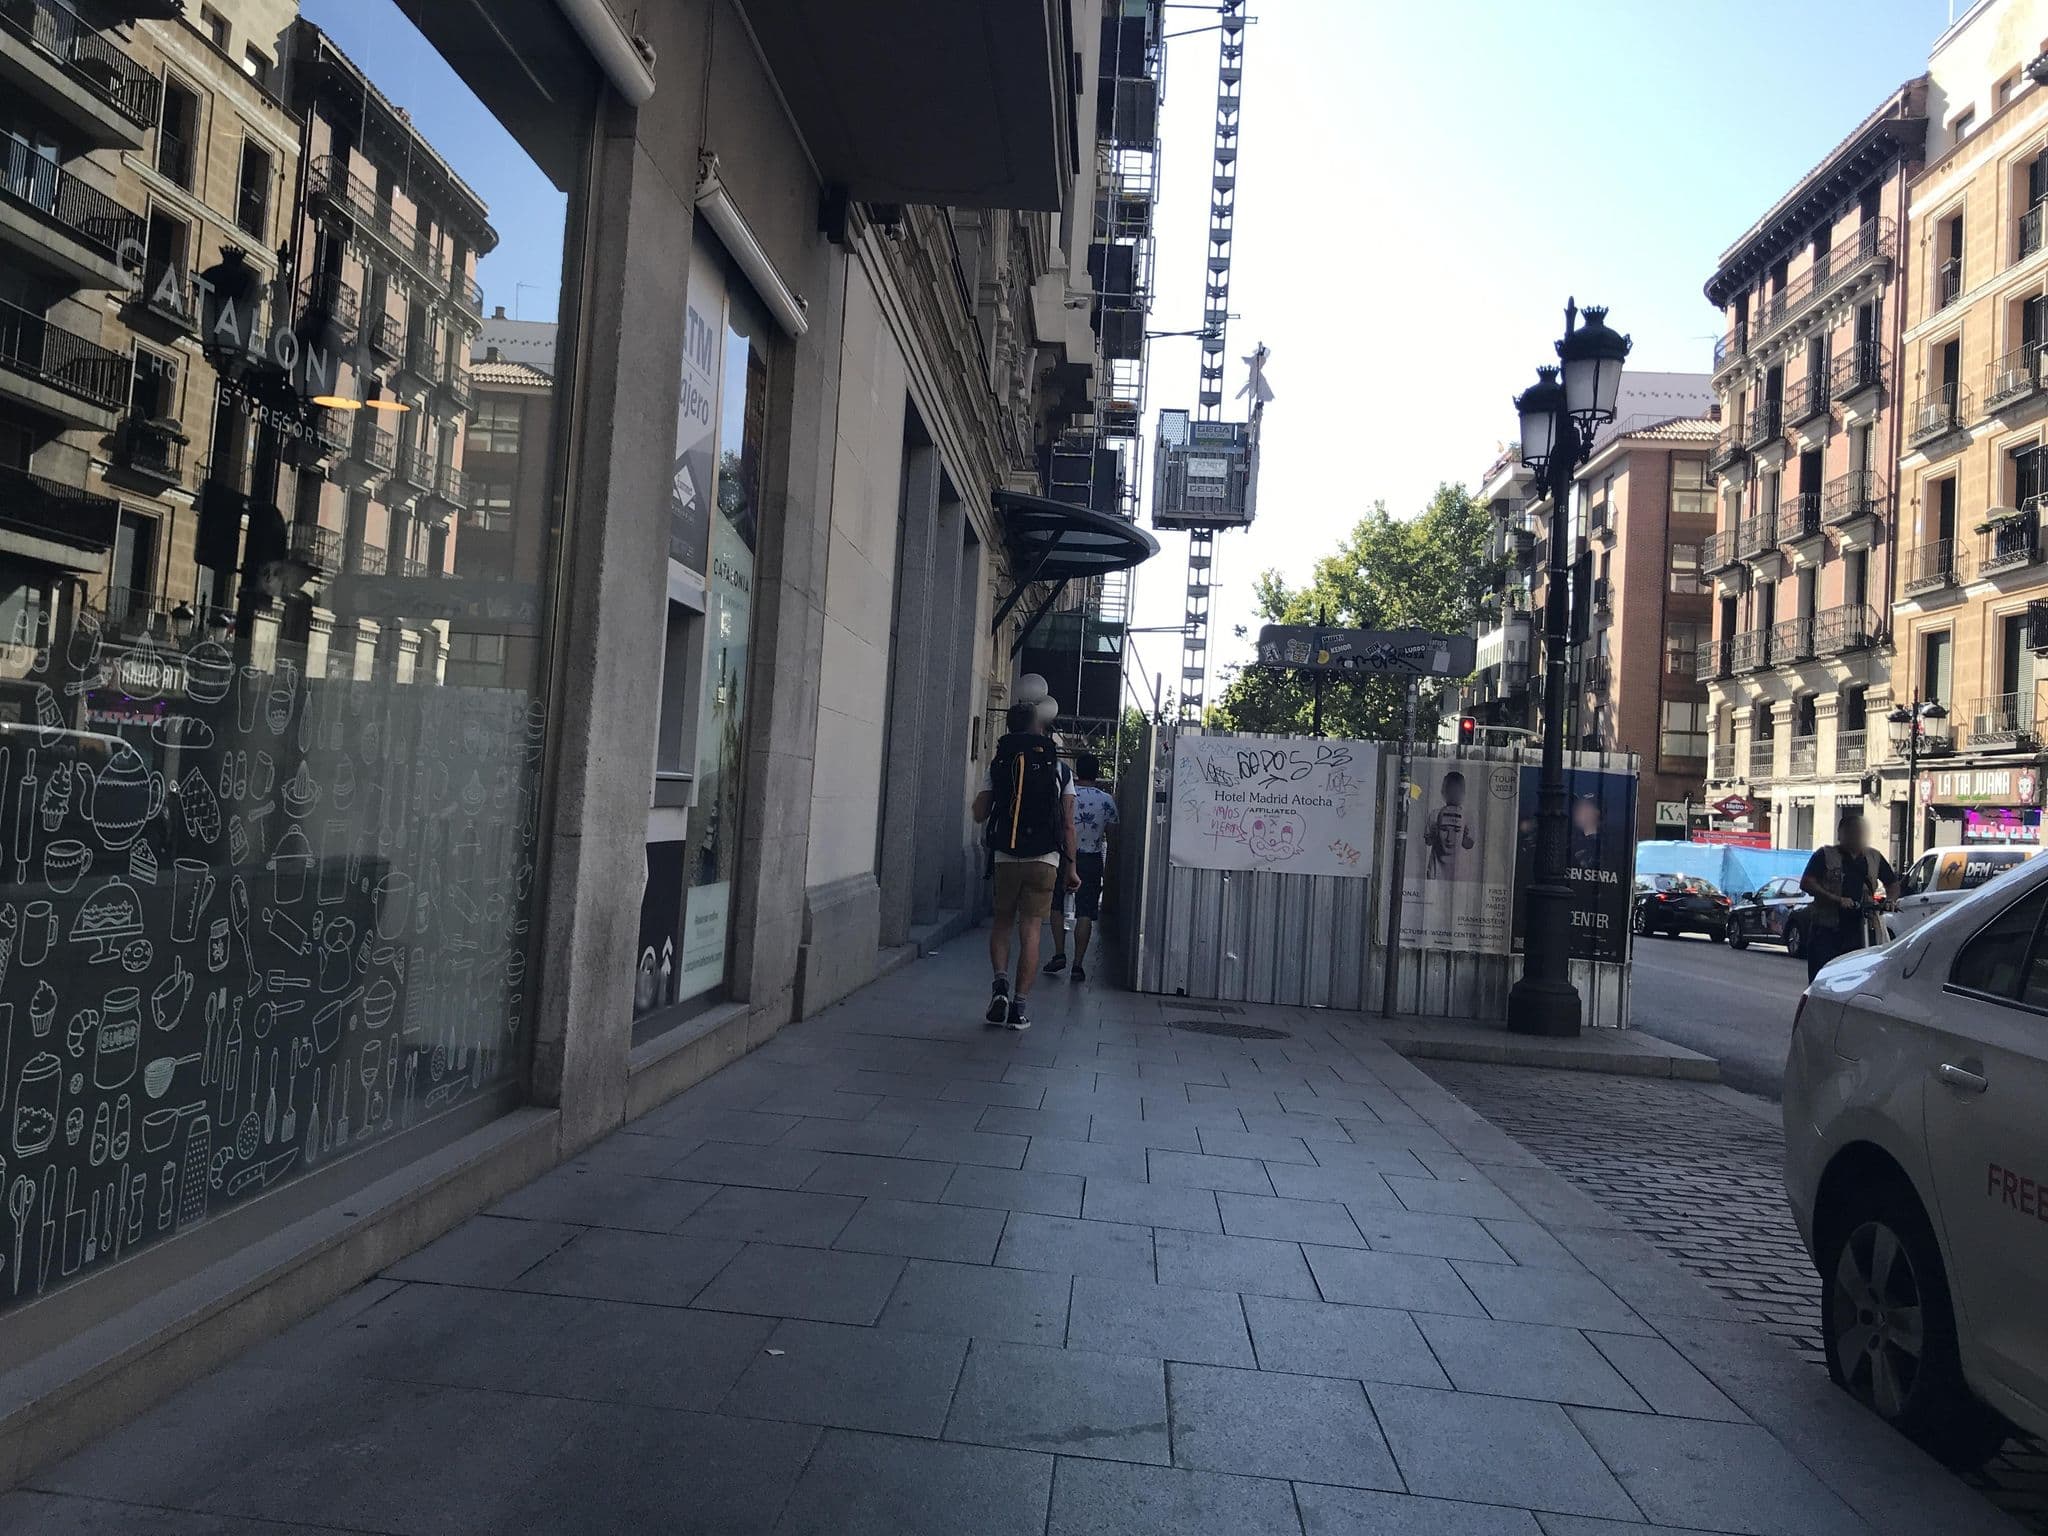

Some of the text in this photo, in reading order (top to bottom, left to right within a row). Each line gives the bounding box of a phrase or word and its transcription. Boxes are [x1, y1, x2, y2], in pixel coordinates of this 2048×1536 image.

[684, 304, 713, 376] TM
[713, 557, 750, 593] CATALONIA
[1494, 775, 1517, 784] TOUR
[1938, 774, 1951, 796] LA
[1214, 790, 1333, 807] Hotel Madrid Atocha
[1725, 802, 1745, 811] Metro
[1249, 807, 1297, 815] AFFILIATED
[1965, 862, 1992, 878] DFM
